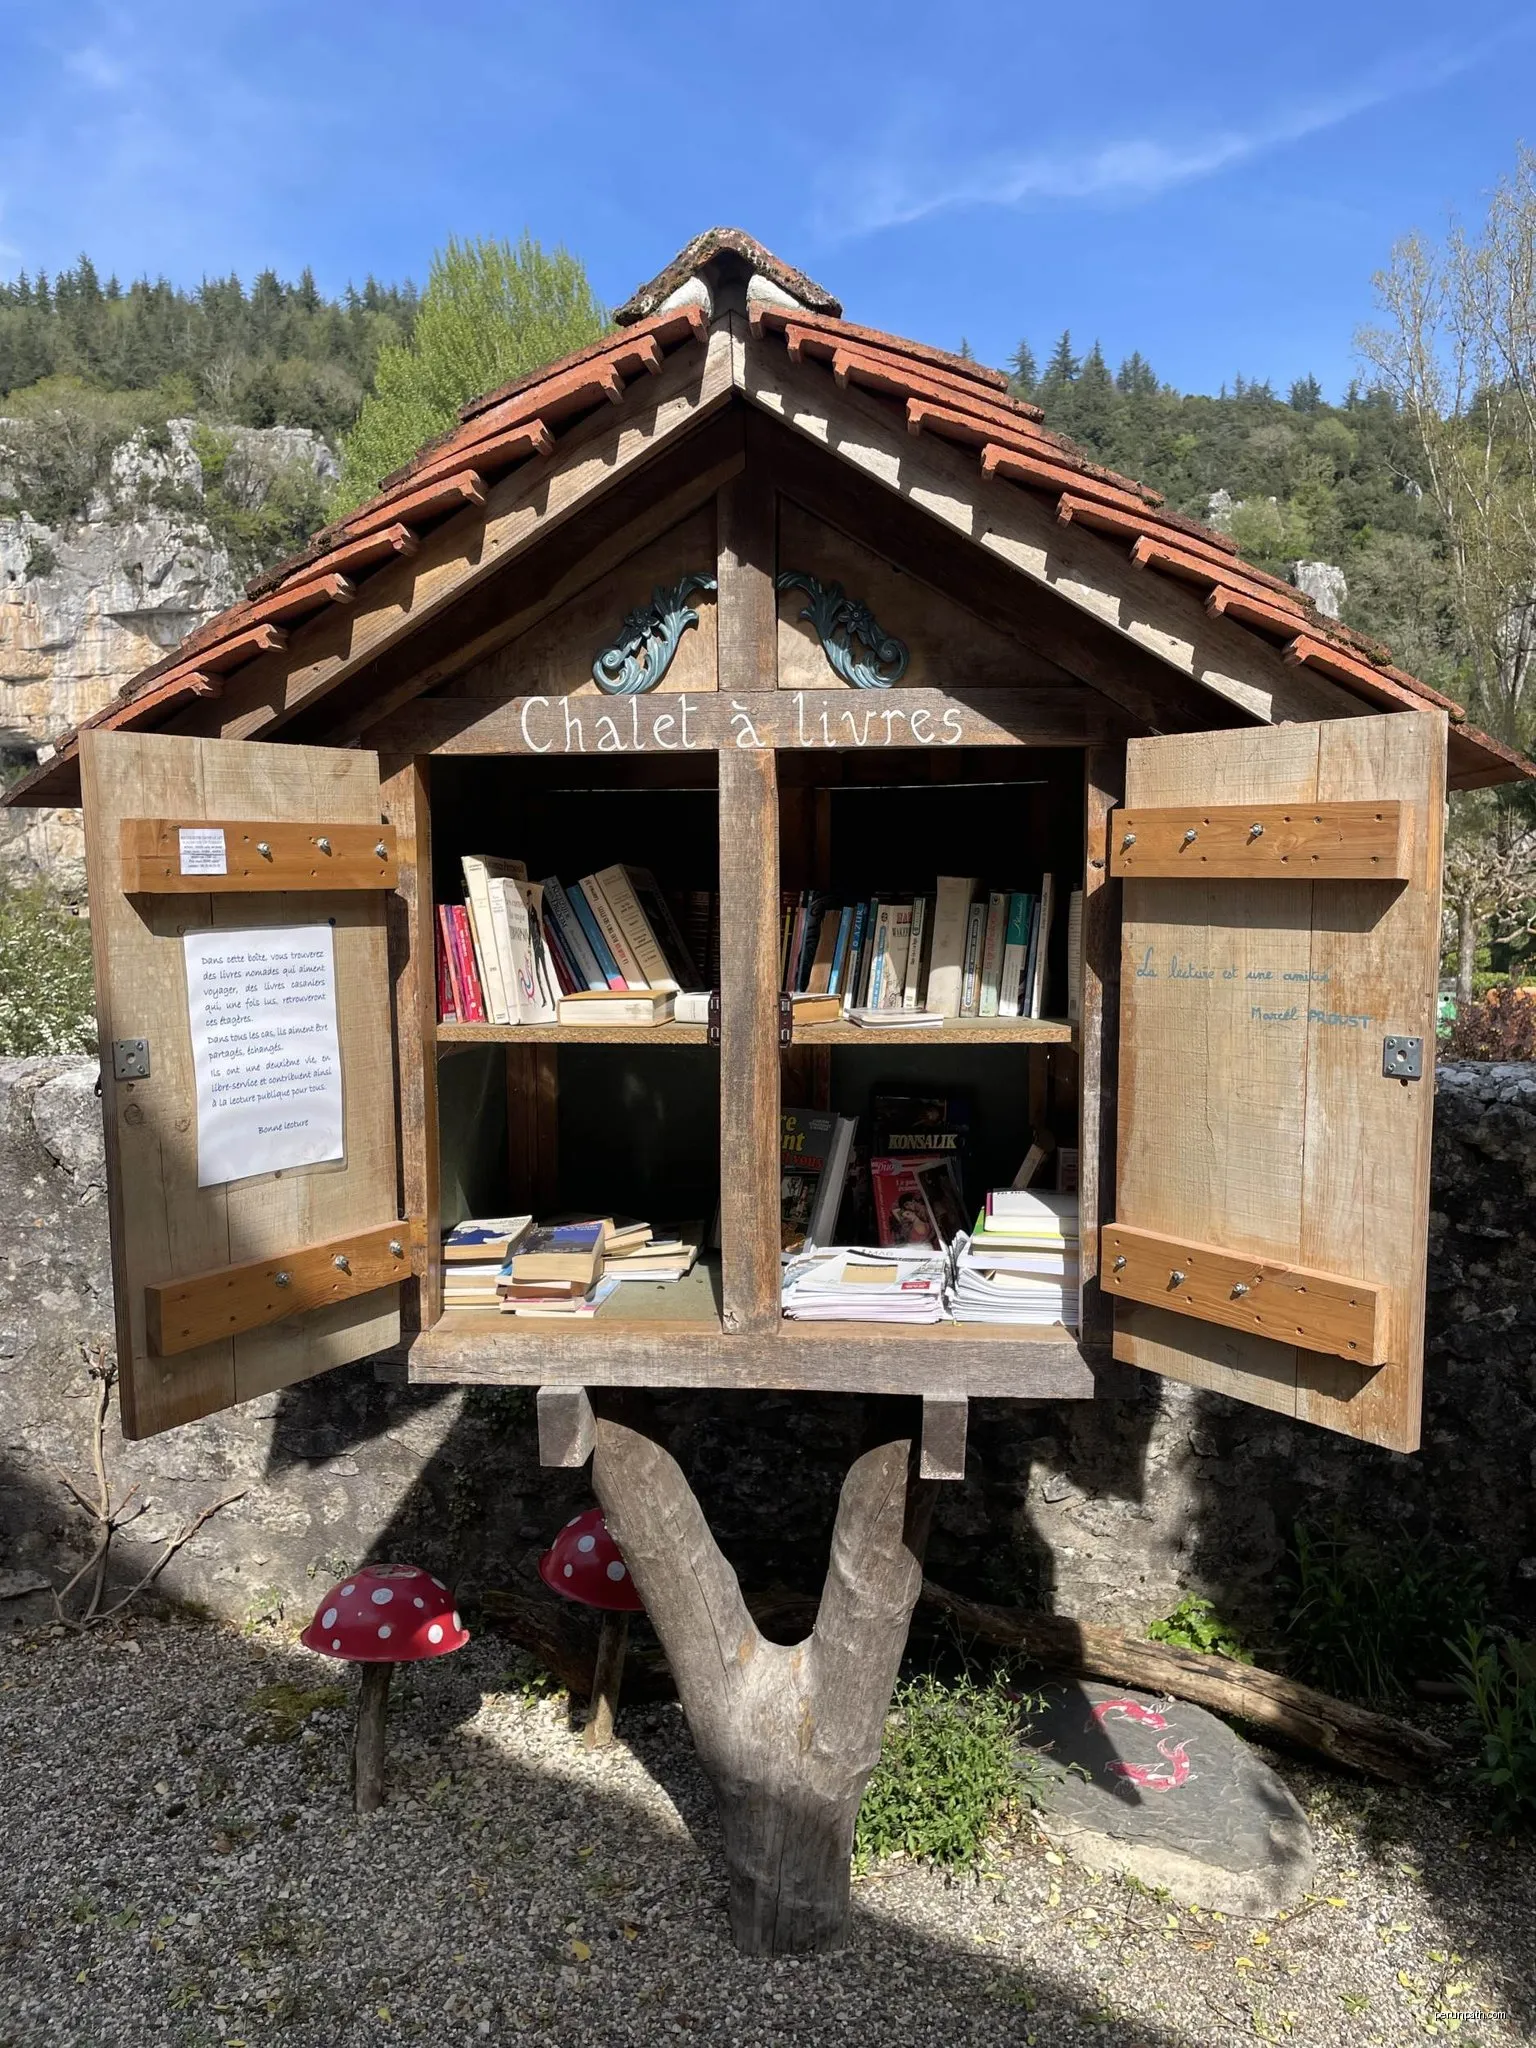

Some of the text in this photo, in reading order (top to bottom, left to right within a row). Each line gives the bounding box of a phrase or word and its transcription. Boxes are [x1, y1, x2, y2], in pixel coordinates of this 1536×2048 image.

[520, 692, 963, 753] Chalet à livres
[201, 956, 223, 965] Dans
[227, 955, 244, 963] cette
[291, 951, 324, 959] trouverez
[1136, 947, 1157, 978] La
[1168, 955, 1215, 979] lecture
[1223, 967, 1239, 979] est
[1246, 971, 1273, 980] une
[203, 964, 326, 980] des livres nomades qui aiment
[203, 978, 326, 999] voyager, des livres casaniers
[245, 999, 260, 1010] fois
[283, 993, 326, 1004] retrouveront
[220, 1015, 253, 1027] étagères.
[1251, 1007, 1300, 1021] Marcel
[207, 1036, 229, 1044] Dans
[230, 1033, 247, 1042] tous
[277, 1027, 286, 1036] ils
[288, 1025, 314, 1034] aiment
[315, 1023, 328, 1032] être
[210, 1069, 221, 1078] Ils
[266, 1058, 300, 1070] deuxième
[211, 1067, 332, 1093] libre-service et contribuent ainsi
[212, 1099, 217, 1107] à
[230, 1095, 256, 1105] lecture
[257, 1089, 290, 1103] publique
[292, 1088, 307, 1098] pour
[258, 1119, 309, 1134] Bonne lecture
[888, 1135, 958, 1149] KONSALIK
